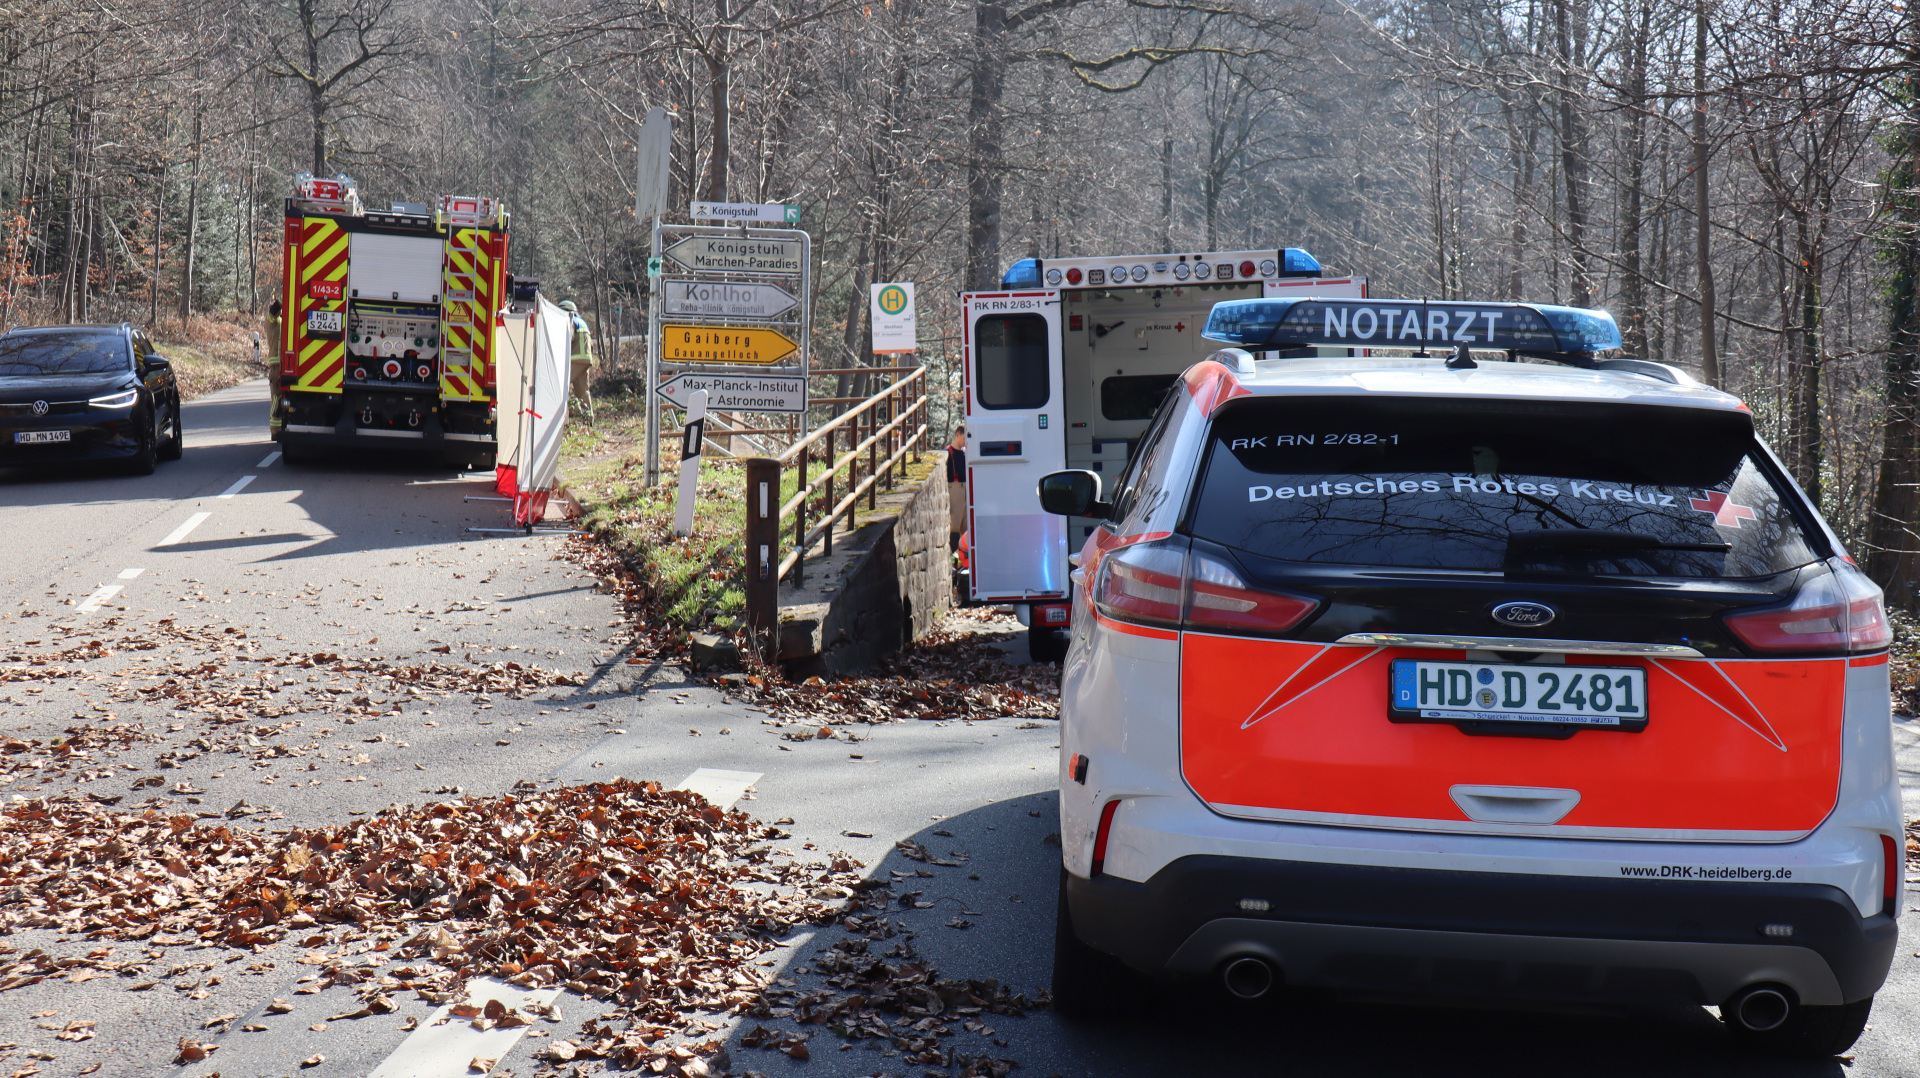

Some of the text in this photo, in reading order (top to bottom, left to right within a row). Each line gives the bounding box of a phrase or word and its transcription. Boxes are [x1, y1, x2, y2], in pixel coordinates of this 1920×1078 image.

[712, 206, 758, 218] Königstuhl
[708, 241, 784, 257] Königstuhl
[695, 255, 798, 270] Märchen-Paradies
[313, 285, 339, 294] 1/43-2
[686, 284, 760, 303] Kohlhof
[680, 303, 724, 313] Reha-Klinik
[974, 300, 1041, 310] RK RN 2/83-1
[316, 312, 328, 320] HD
[310, 320, 337, 330] S 2441
[1324, 308, 1503, 342] NOTARZT
[684, 331, 750, 347] Gaiberg
[674, 348, 759, 361] Gauangelloch
[683, 379, 799, 393] Max-Planck-Institut
[717, 395, 785, 407] Astronomie
[20, 433, 31, 442] HD
[49, 431, 69, 440] 149E
[1231, 433, 1399, 450] RK RN 2/82-1
[1249, 476, 1678, 508] Deutsches Rotes Kreuz
[1507, 606, 1541, 621] Ford
[1402, 690, 1410, 700] D
[1420, 668, 1639, 713] HD D 2481
[1620, 865, 1792, 881] www.DRK-heidelberg.de
